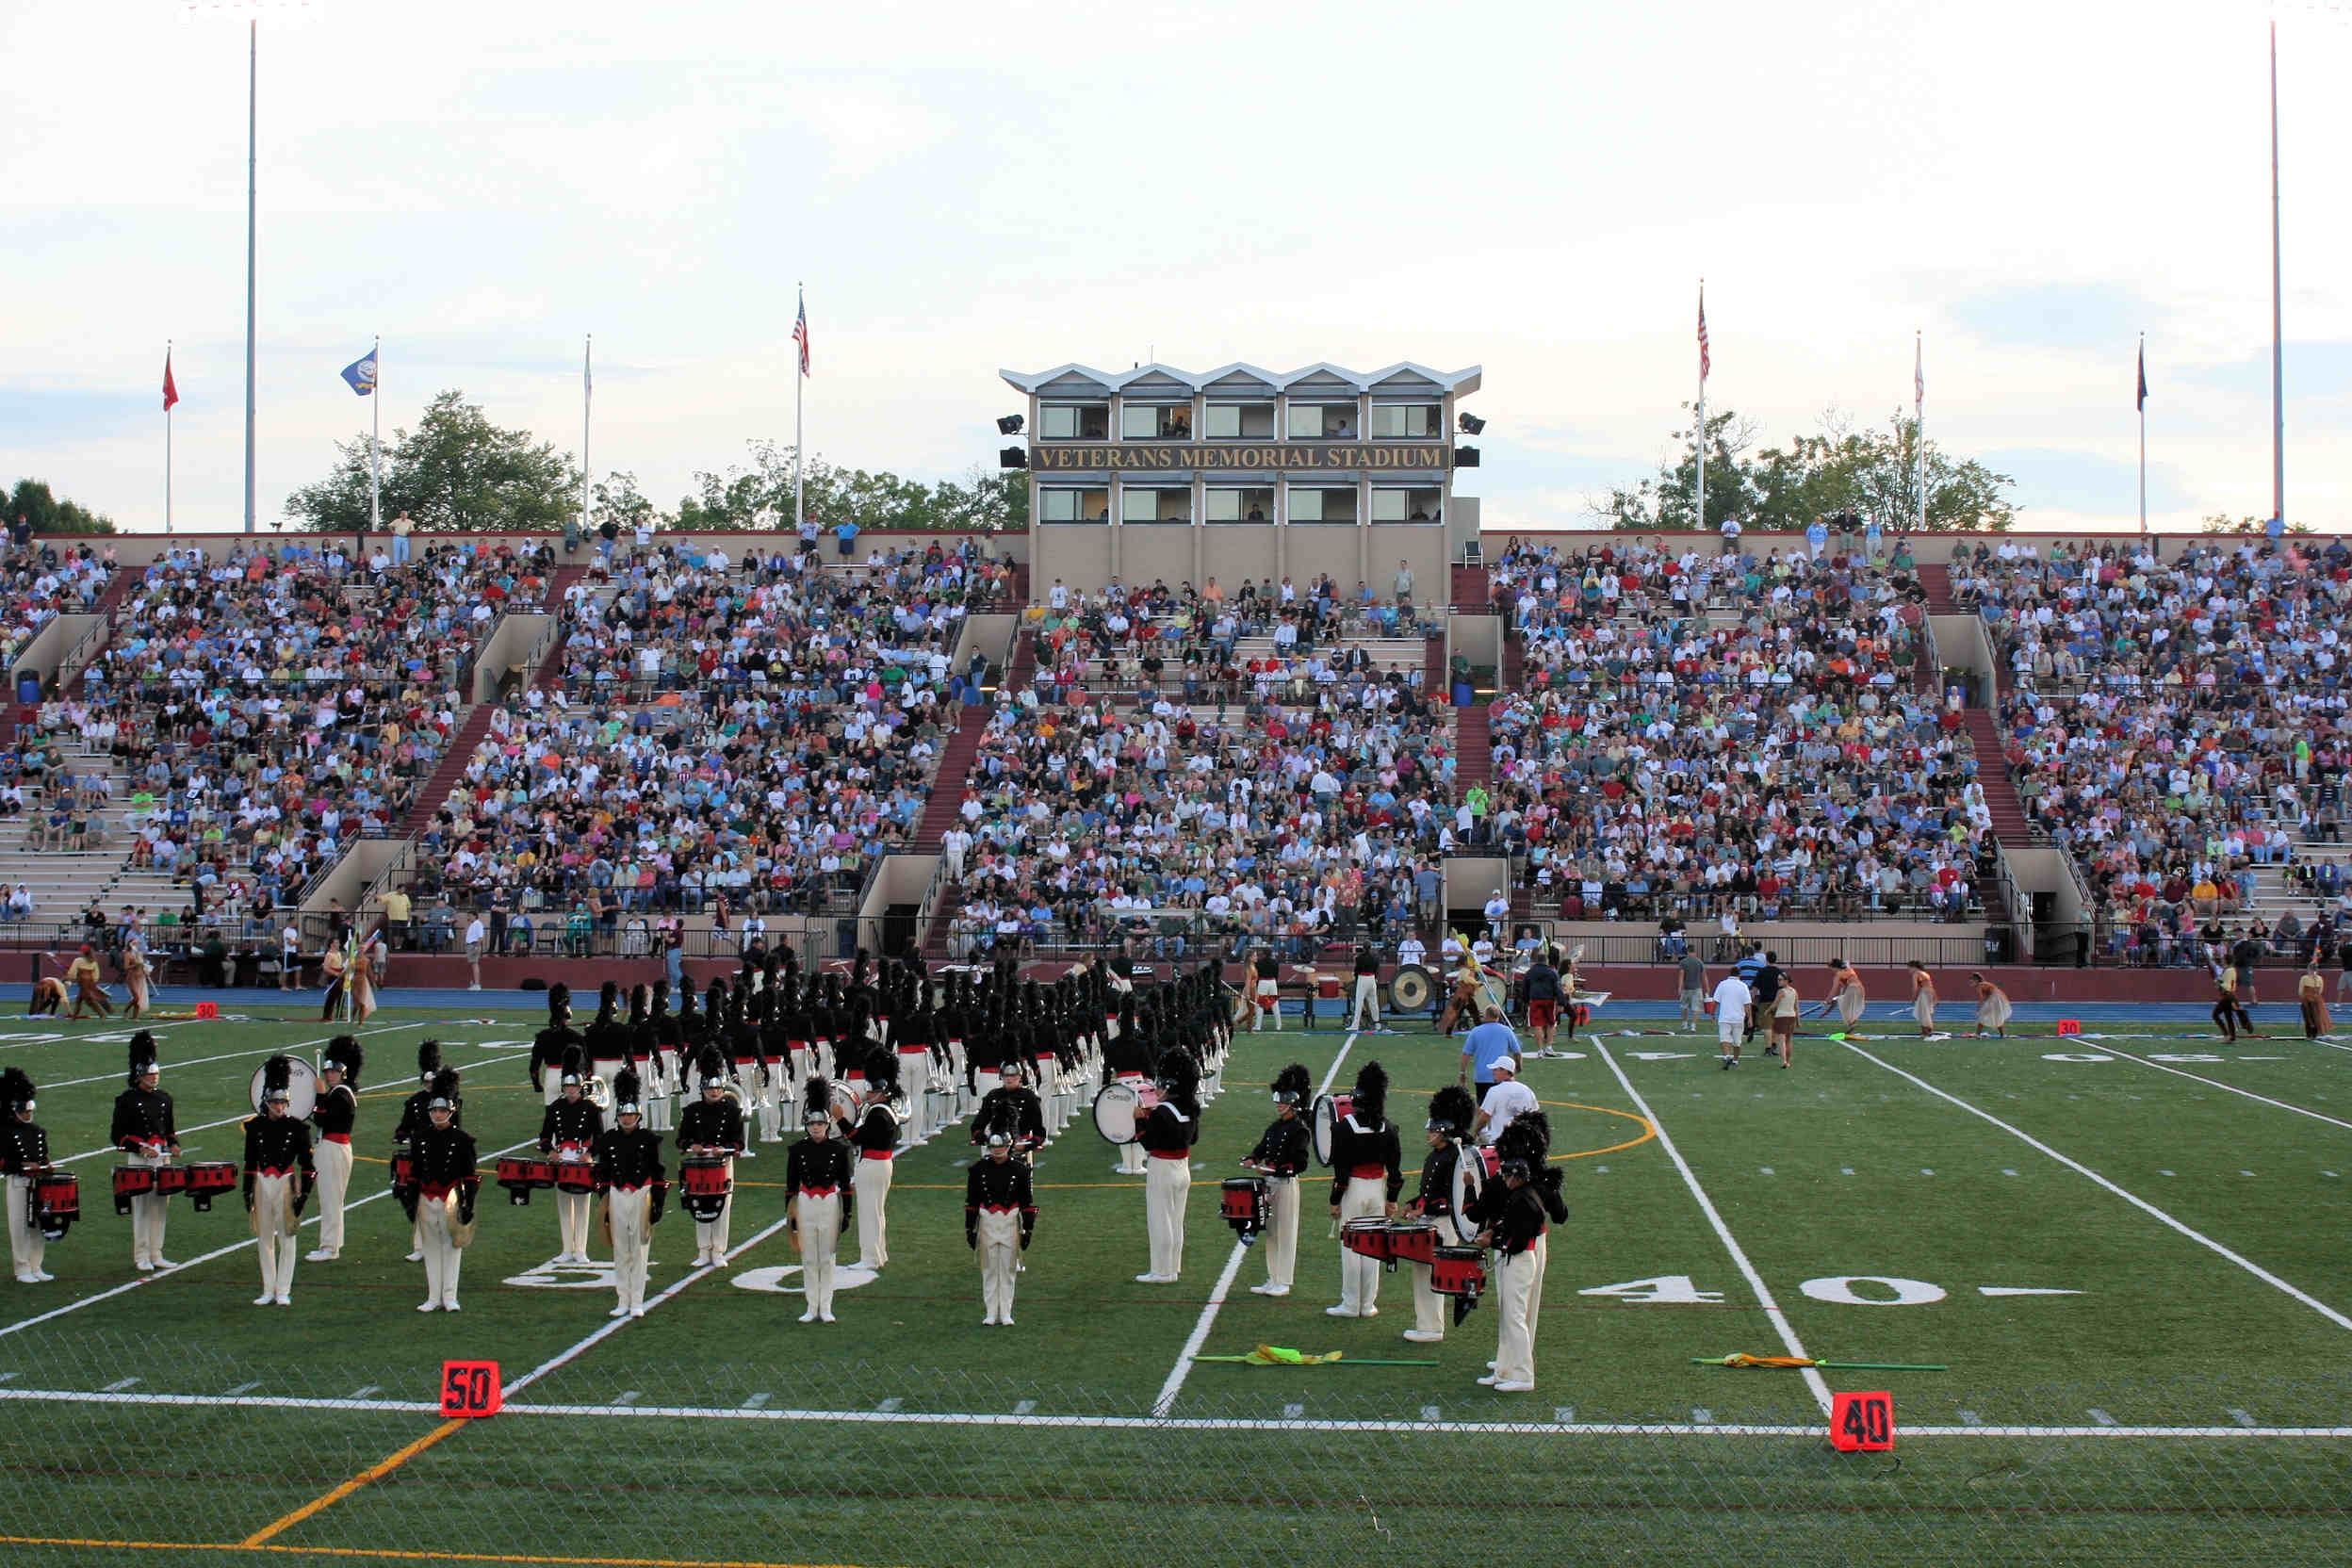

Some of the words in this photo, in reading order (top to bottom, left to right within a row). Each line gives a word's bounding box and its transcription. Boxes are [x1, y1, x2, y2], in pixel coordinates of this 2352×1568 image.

[1039, 449, 1171, 467] VETERANS
[1179, 449, 1321, 467] MEMORIAL
[1328, 448, 1441, 467] STADIUM
[2061, 1022, 2078, 1034] 30
[446, 1367, 491, 1410] 50
[1843, 1399, 1888, 1444] 40
